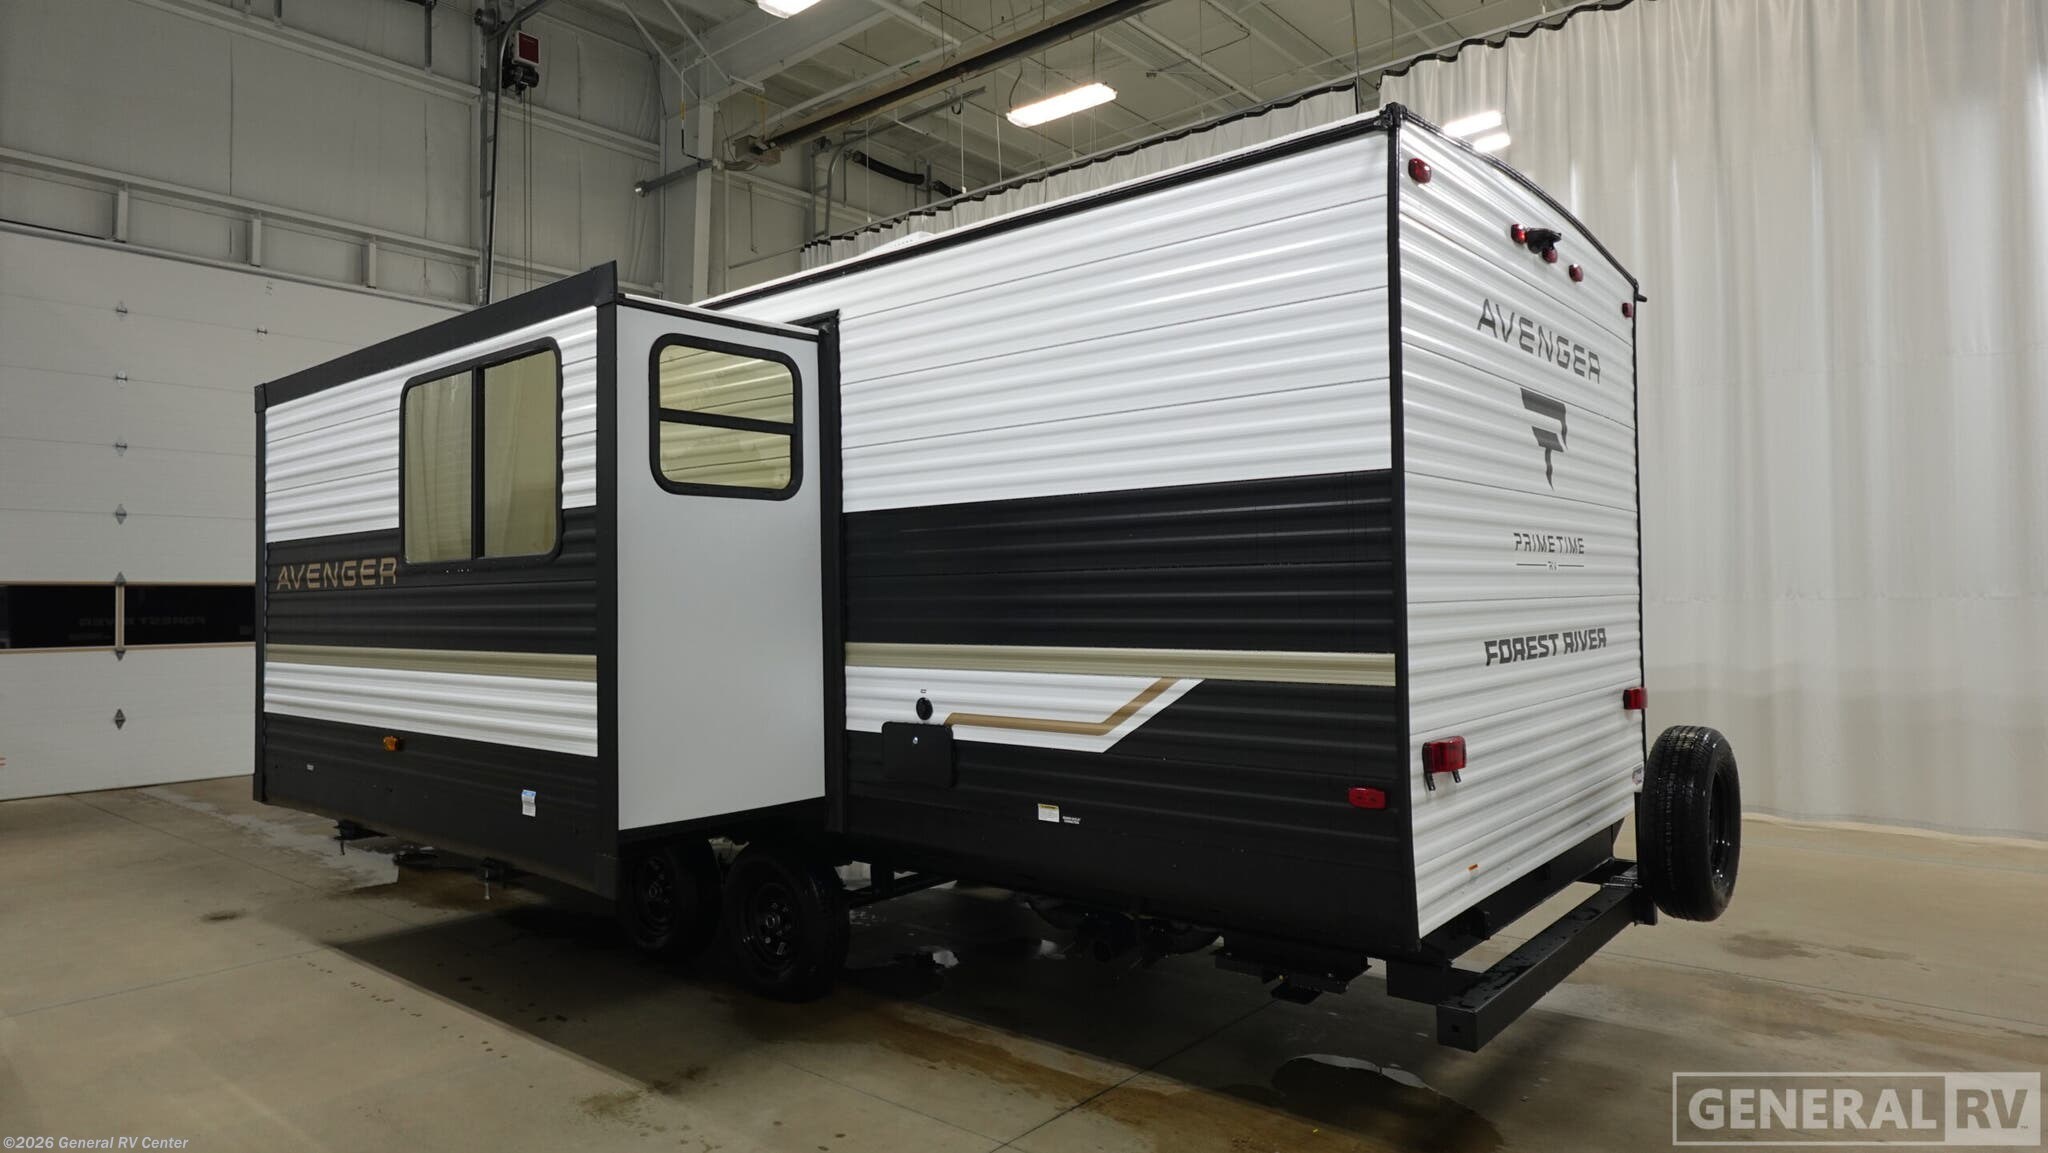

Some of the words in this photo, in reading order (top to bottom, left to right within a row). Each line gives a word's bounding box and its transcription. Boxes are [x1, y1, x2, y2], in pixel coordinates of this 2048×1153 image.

[1477, 298, 1600, 384] AVENGER
[1513, 532, 1584, 554] PRIMETIME
[276, 557, 397, 590] AVENGER
[1484, 633, 1559, 666] FOREST
[1562, 627, 1607, 654] RIVER
